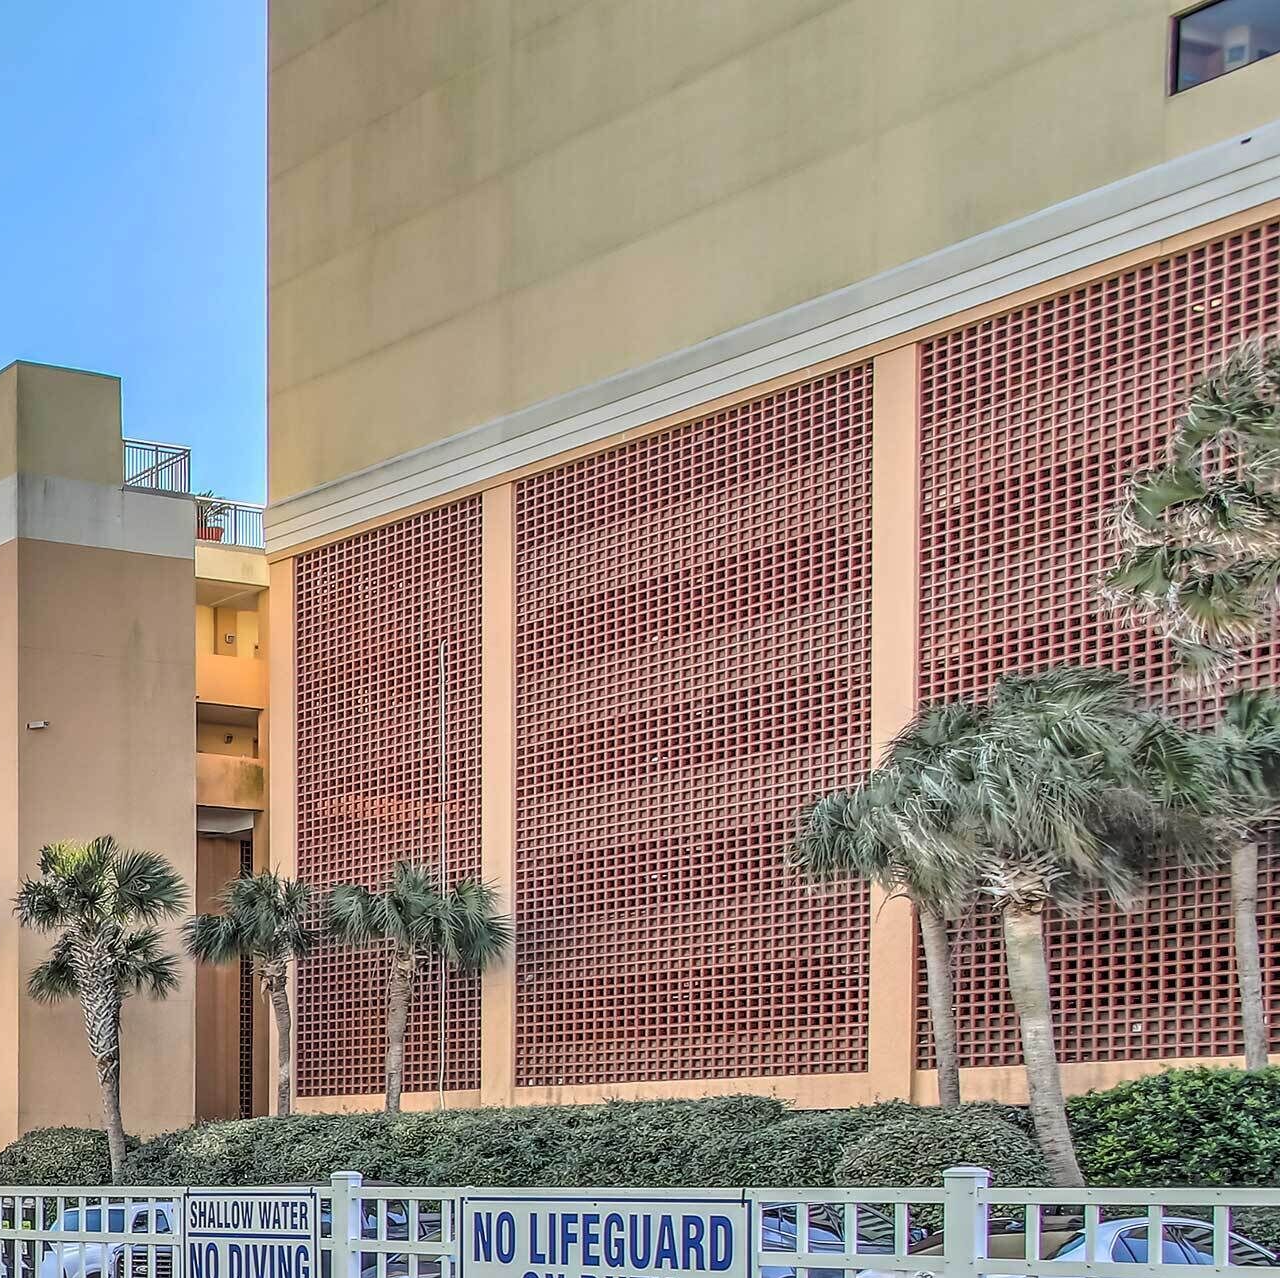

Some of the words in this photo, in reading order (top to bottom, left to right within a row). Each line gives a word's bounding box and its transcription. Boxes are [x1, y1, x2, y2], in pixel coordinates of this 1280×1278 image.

[190, 1200, 253, 1229] SHALLOW
[258, 1201, 309, 1230] WATER
[473, 1211, 516, 1264] NO
[529, 1212, 734, 1271] LIFEGUARD
